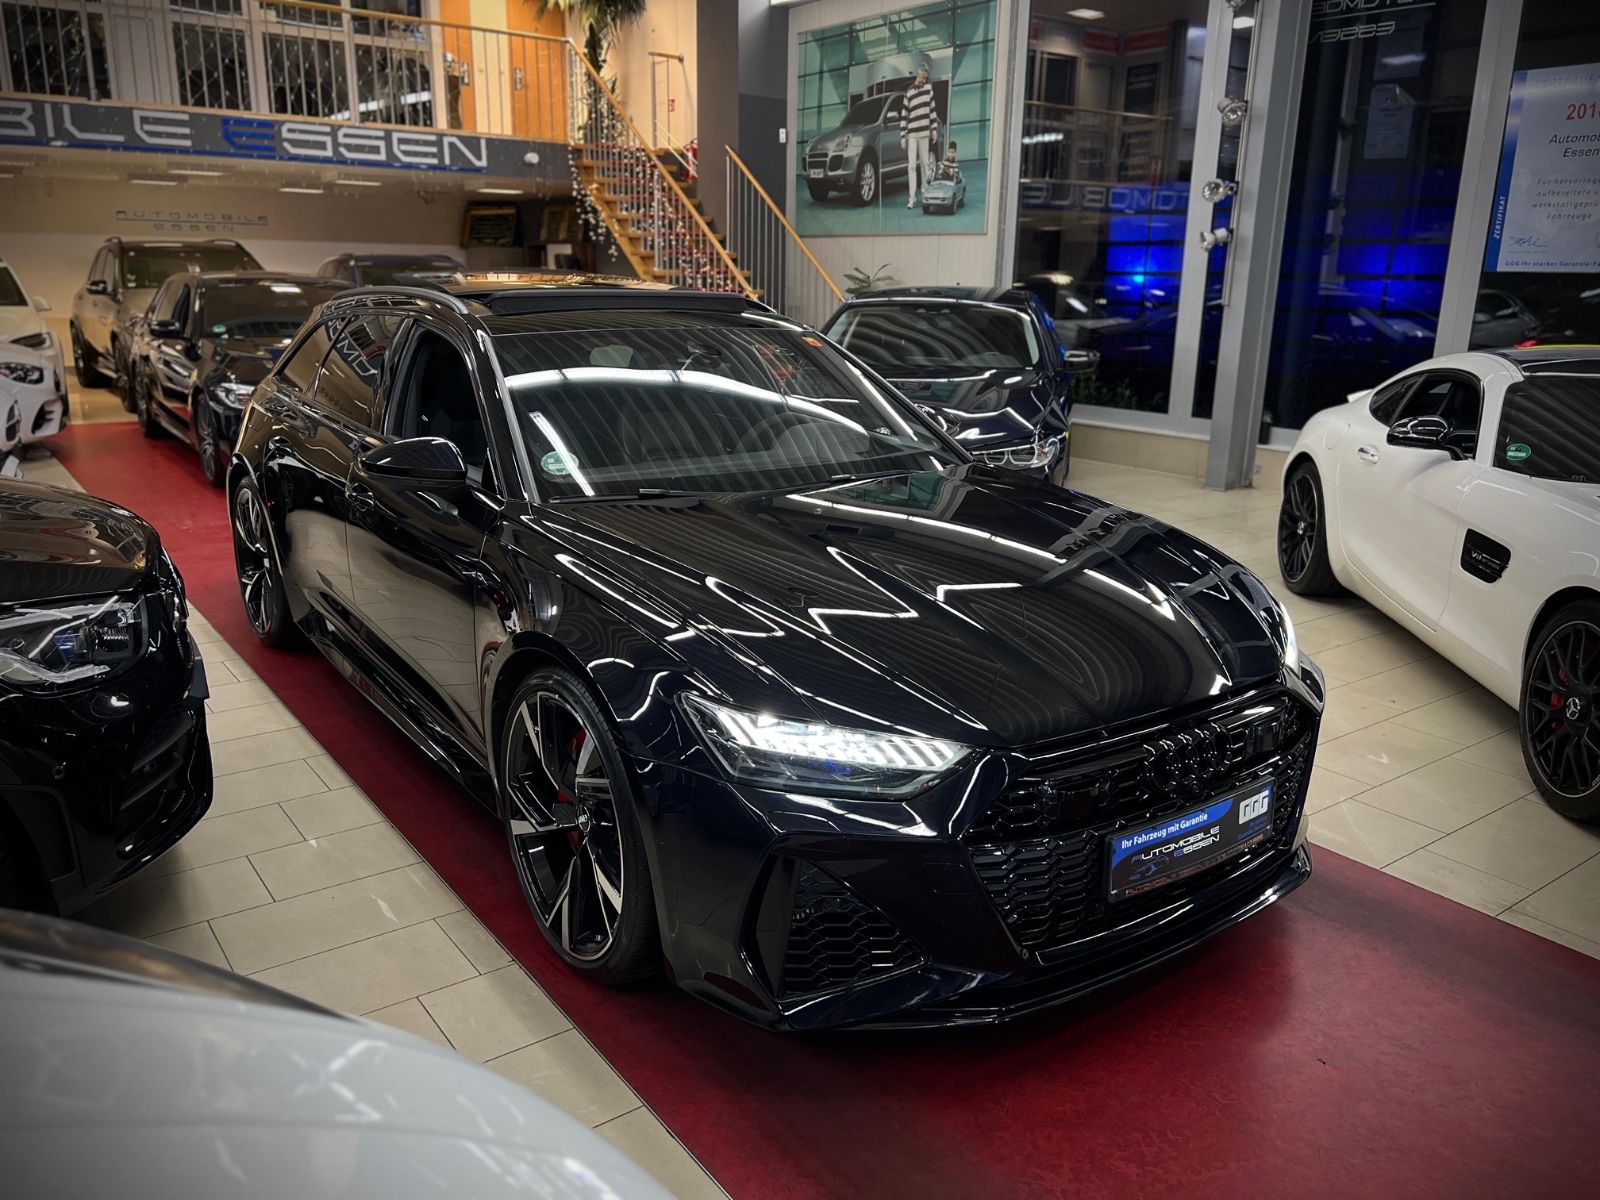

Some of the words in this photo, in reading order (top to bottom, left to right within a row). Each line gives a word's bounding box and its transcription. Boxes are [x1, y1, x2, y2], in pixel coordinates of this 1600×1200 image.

[1566, 102, 1600, 121] 201
[222, 117, 488, 167] ESSEN
[1562, 147, 1600, 158] Essen
[115, 210, 268, 224] AUTOMOBILE
[1493, 195, 1507, 239] ZERTIFIKAT
[1121, 839, 1133, 849] Ihr
[1133, 828, 1167, 846] Fahrzeug
[1167, 824, 1180, 834] mit
[1180, 812, 1208, 830] Garantie
[1132, 826, 1220, 864] AUTOMOBILE
[1174, 834, 1220, 858] ESSEN
